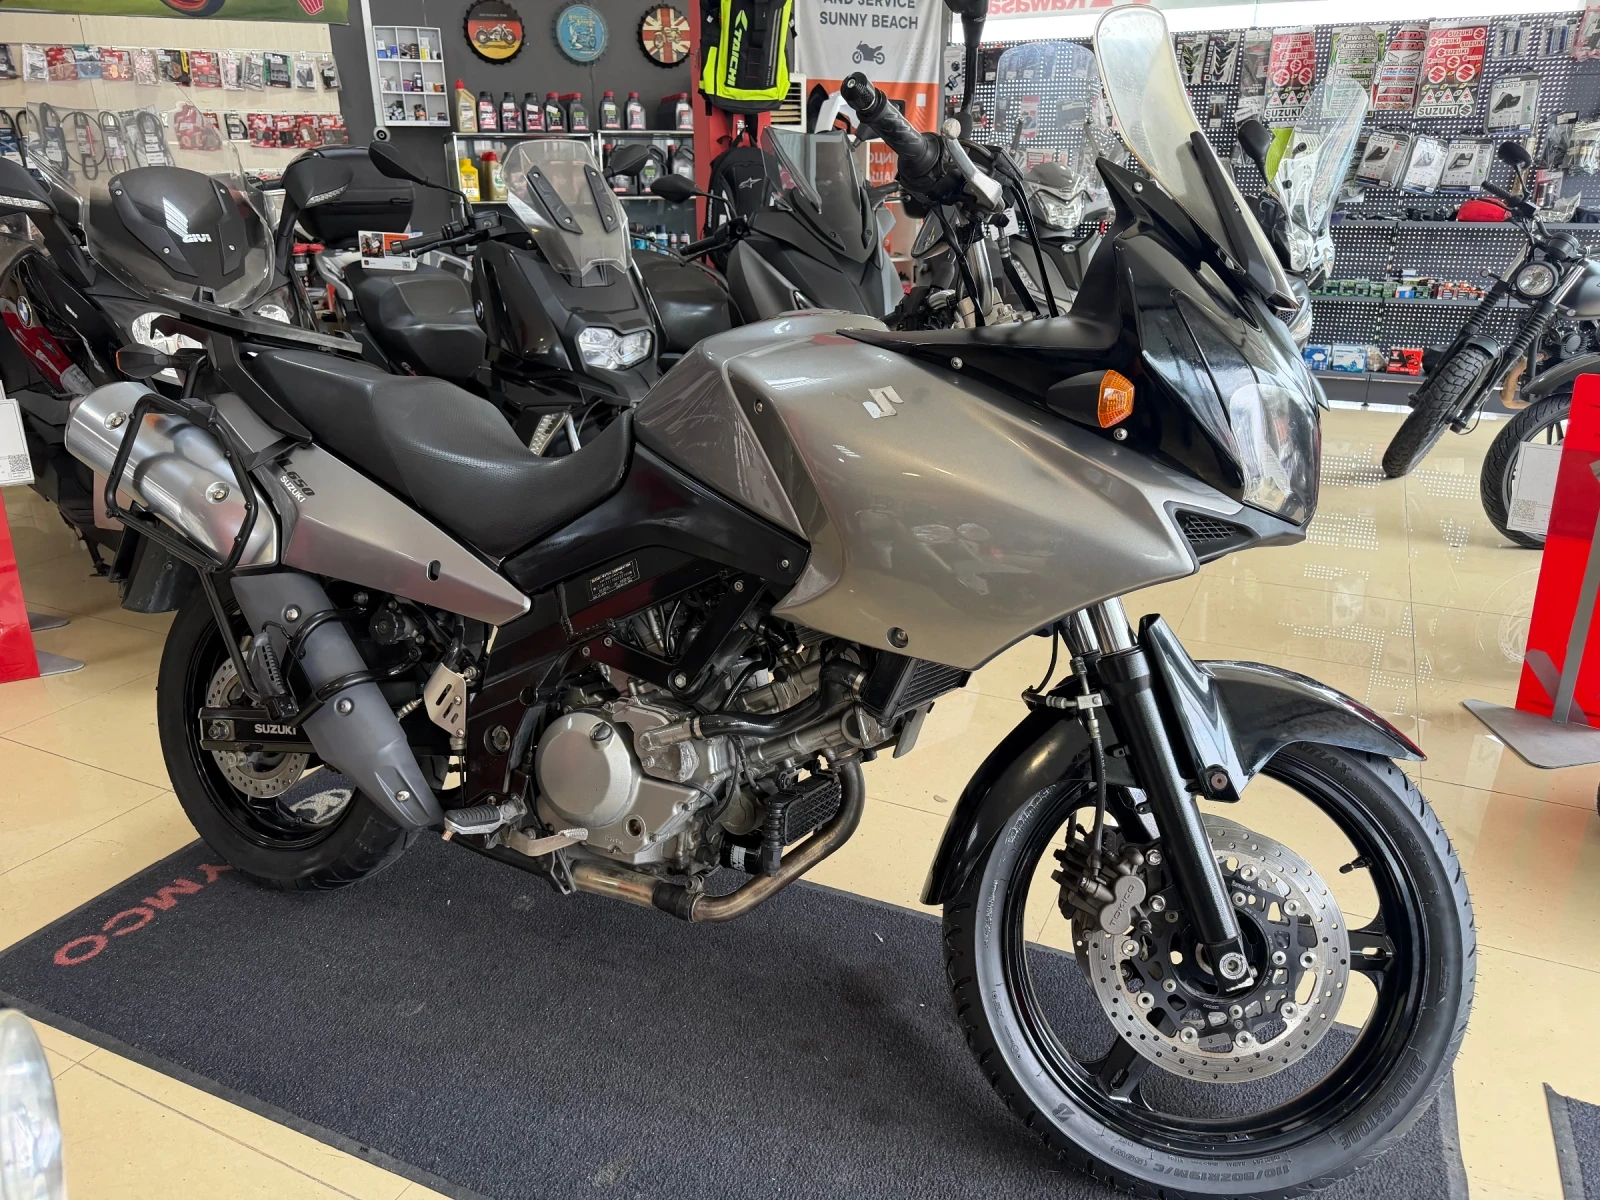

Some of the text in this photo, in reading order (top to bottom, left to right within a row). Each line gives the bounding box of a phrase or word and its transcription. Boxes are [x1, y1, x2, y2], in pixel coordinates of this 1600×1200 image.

[819, 11, 919, 29] SUNNY BEACH
[727, 28, 743, 87] TAICHI
[1265, 108, 1301, 119] SUZUKI
[1418, 108, 1459, 117] SUZUKI
[182, 233, 212, 243] GIVI
[280, 475, 306, 503] SUZUKI
[254, 723, 297, 736] SUZUKI
[54, 863, 236, 967] YMCO
[1109, 883, 1136, 926] TOKICO
[1338, 1057, 1429, 1151] BRIDGESTONE
